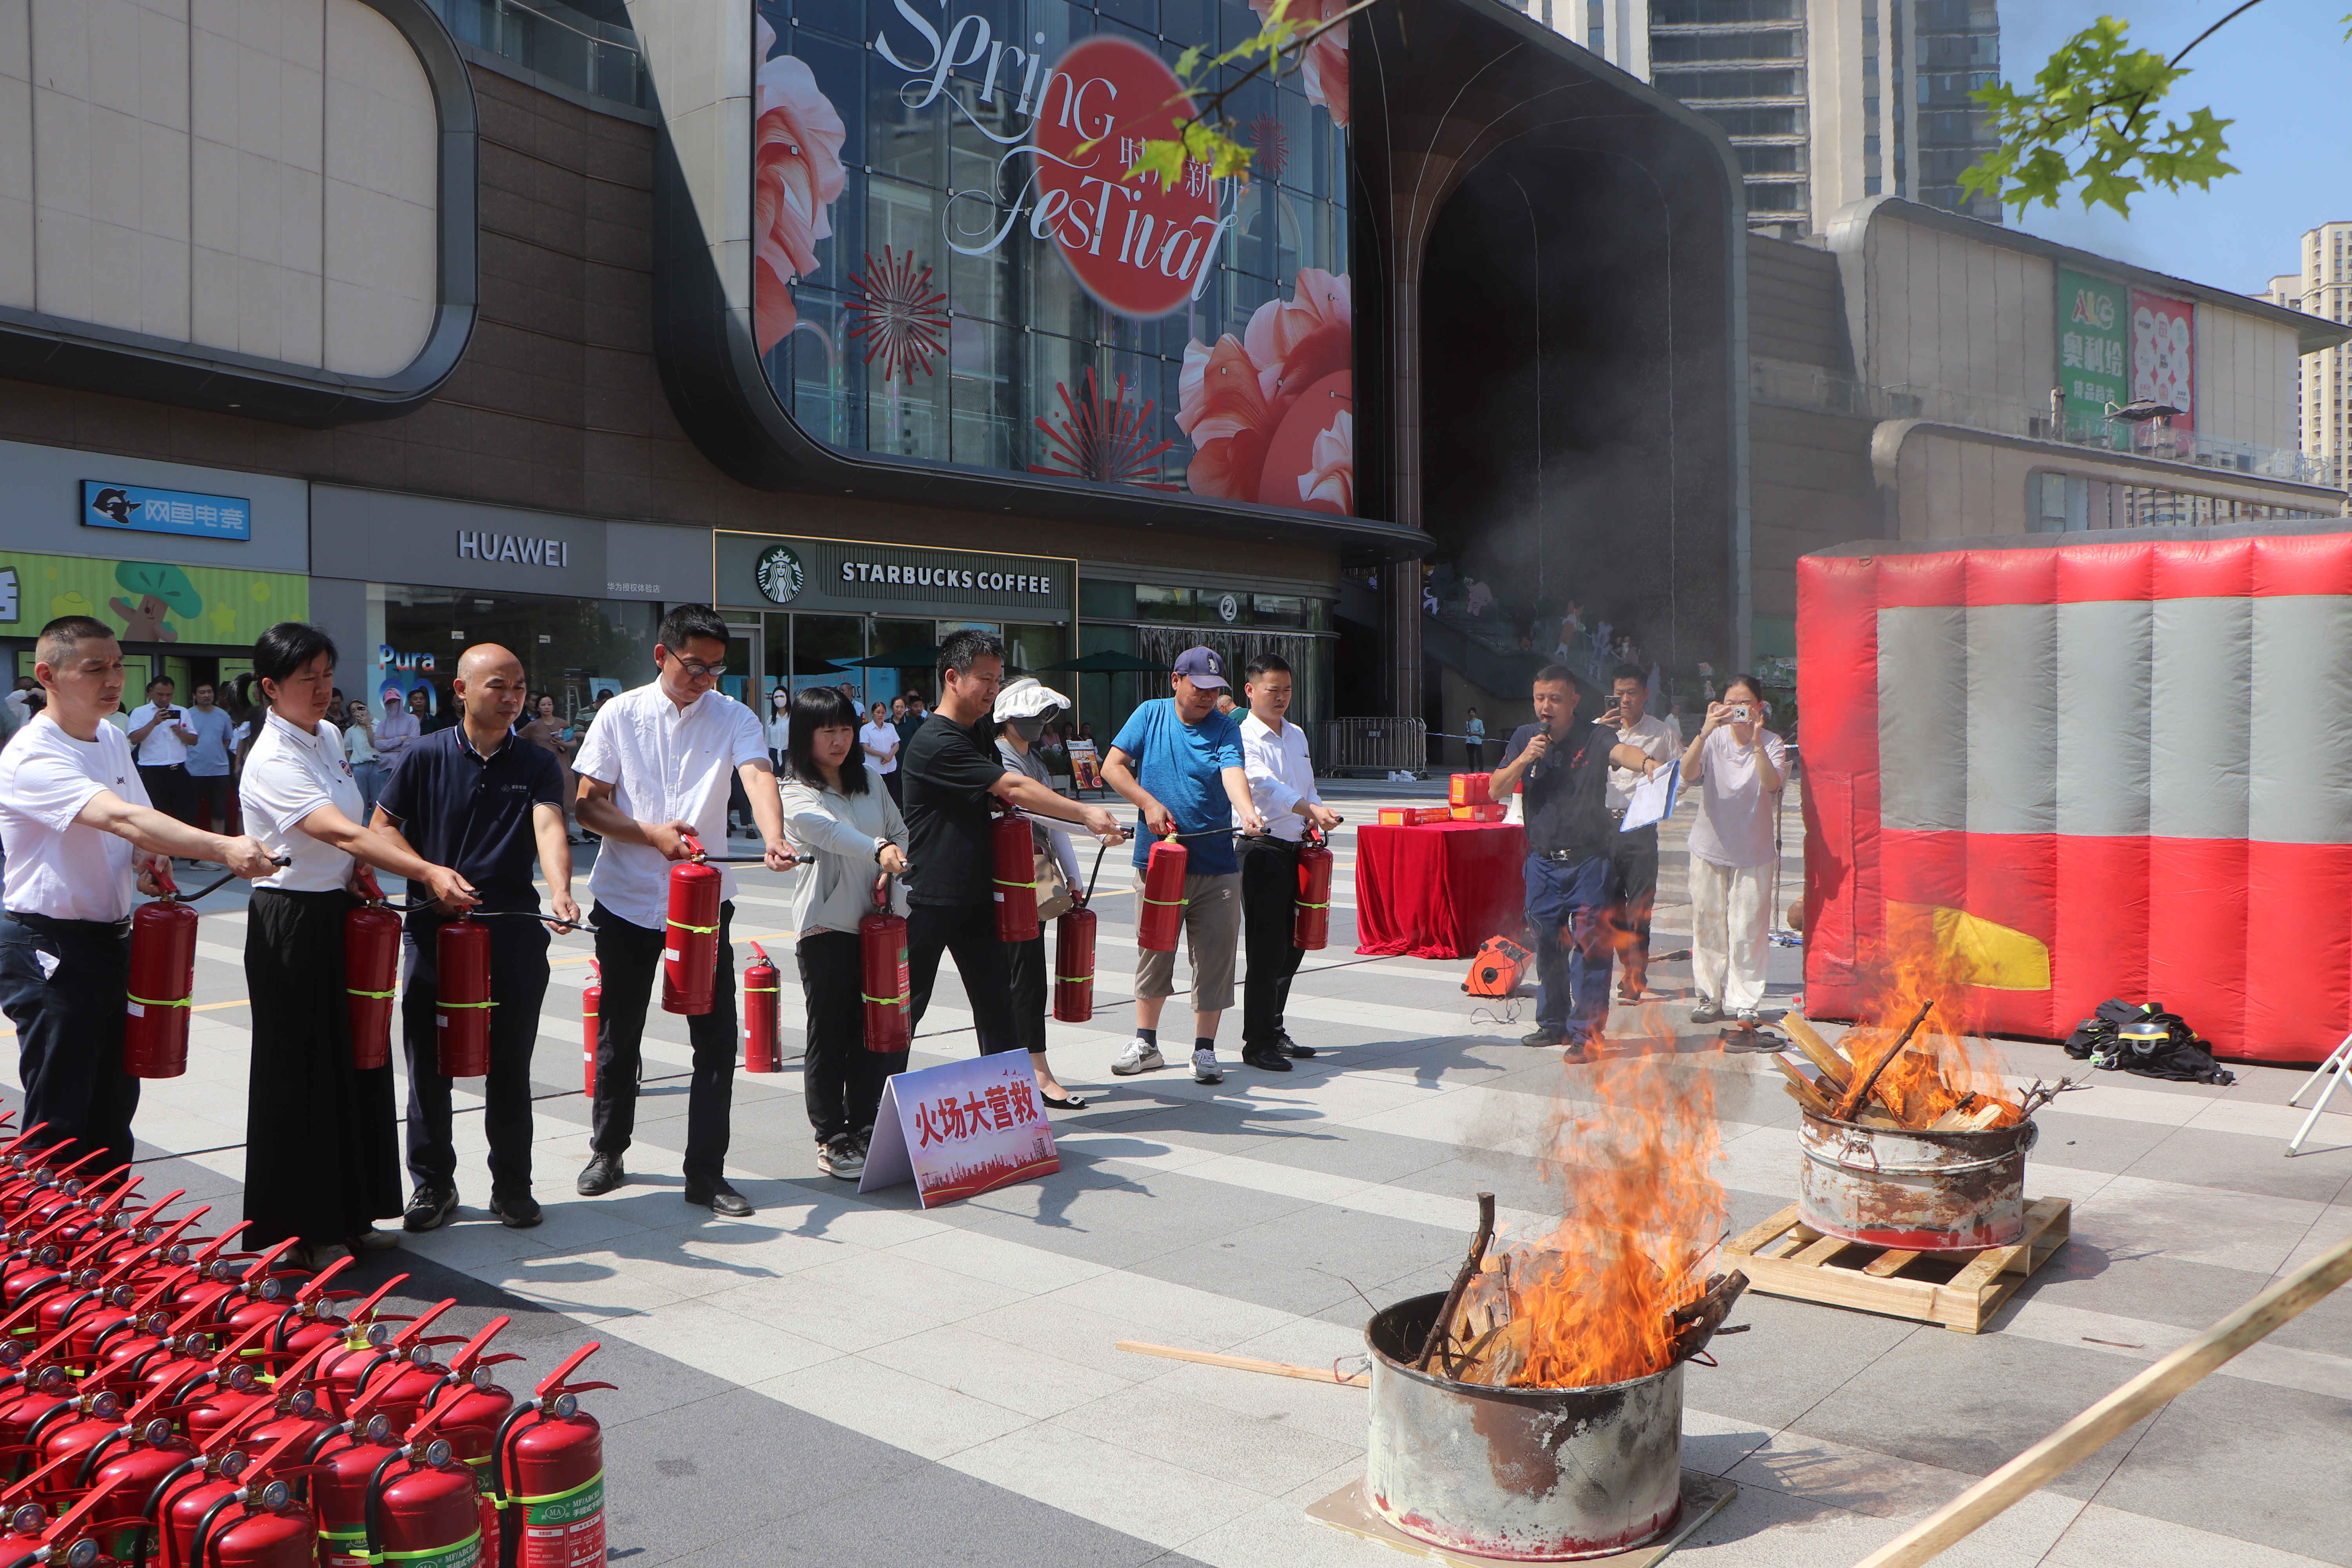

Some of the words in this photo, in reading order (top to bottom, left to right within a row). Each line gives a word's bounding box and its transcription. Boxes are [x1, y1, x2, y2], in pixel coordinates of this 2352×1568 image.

[145, 499, 244, 530] 网鱼电竞
[458, 530, 567, 567] HUAWEI
[607, 581, 660, 593] 华为授权体验店
[842, 562, 972, 589] STARBUCKS
[978, 572, 1051, 594] COFFEE
[1224, 599, 1233, 616] 2
[379, 644, 434, 671] Pura
[915, 1080, 1038, 1148] 火场大营救
